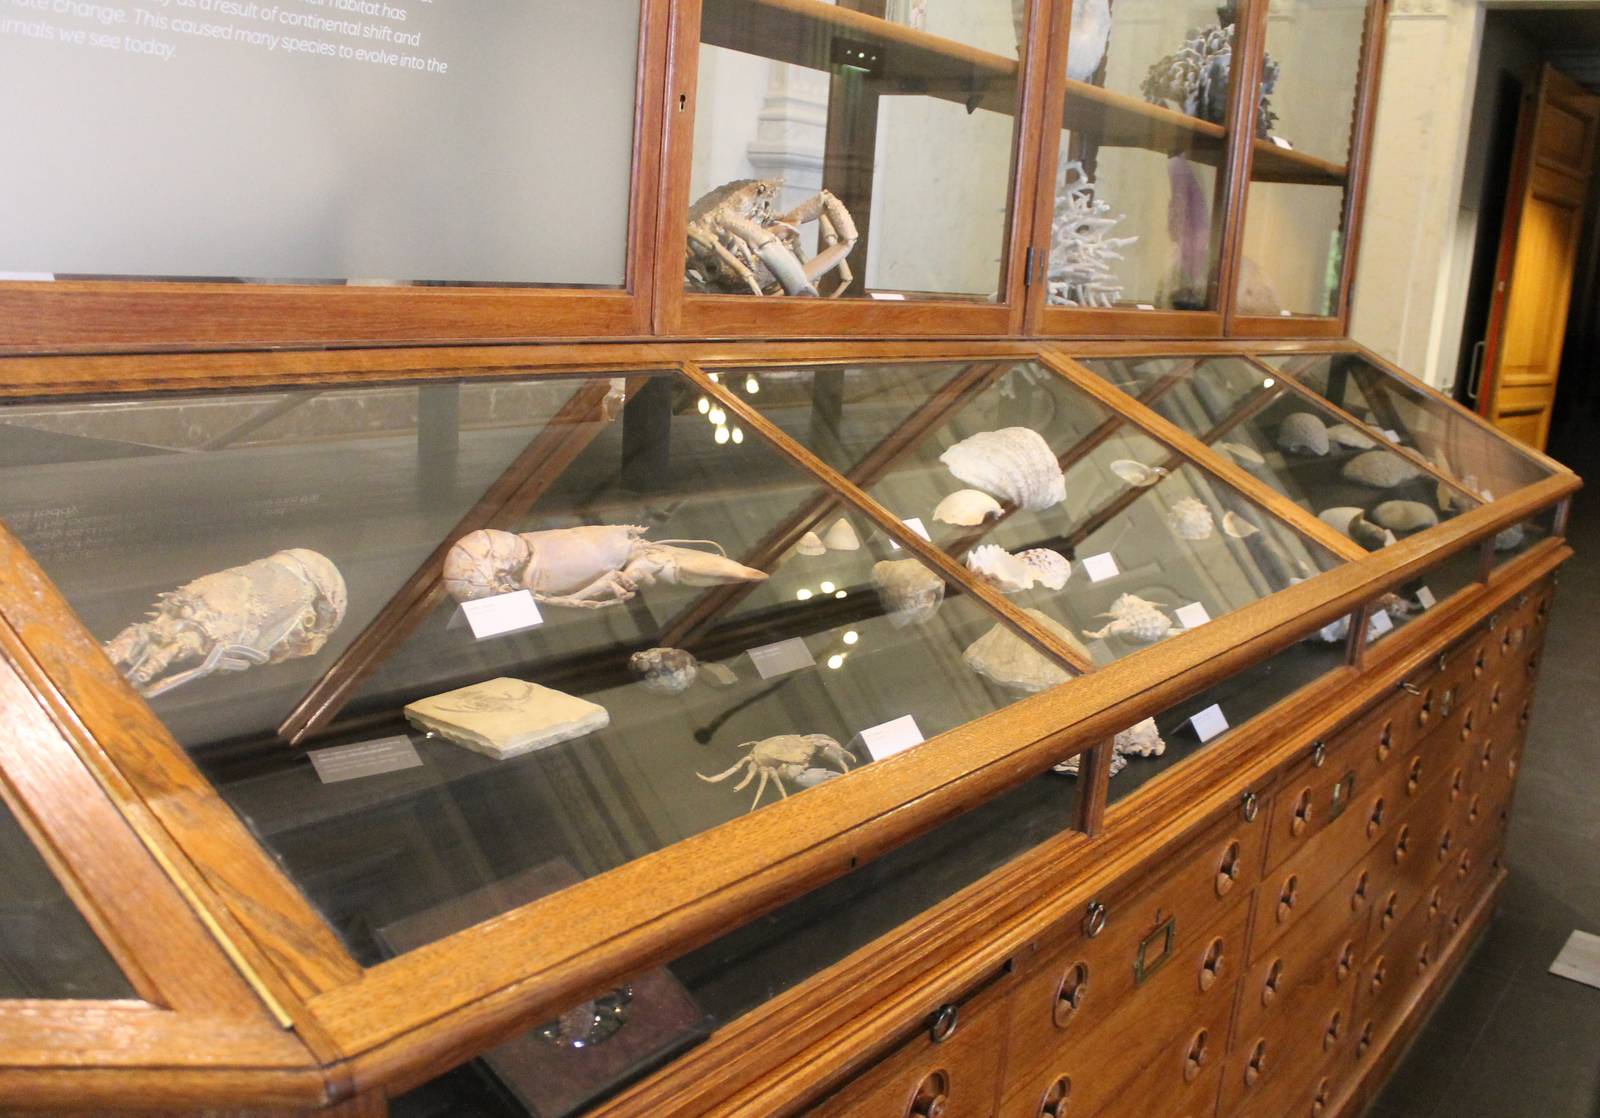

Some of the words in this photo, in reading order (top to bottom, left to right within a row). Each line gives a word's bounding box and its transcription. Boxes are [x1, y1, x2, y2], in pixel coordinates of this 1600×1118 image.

[199, 0, 211, 11] a
[213, 0, 259, 19] result
[261, 6, 280, 21] of
[280, 11, 362, 36] continental
[363, 23, 393, 42] shift
[394, 31, 421, 47] and
[382, 3, 408, 21] has
[59, 27, 87, 46] we
[88, 31, 121, 50] see
[124, 36, 177, 61] today.
[134, 8, 169, 31] This
[171, 19, 234, 40] caused
[234, 29, 281, 51] many
[281, 36, 337, 56] species
[339, 43, 353, 59] to
[355, 48, 399, 66] evolve
[400, 52, 425, 70] into
[427, 57, 449, 74] the
